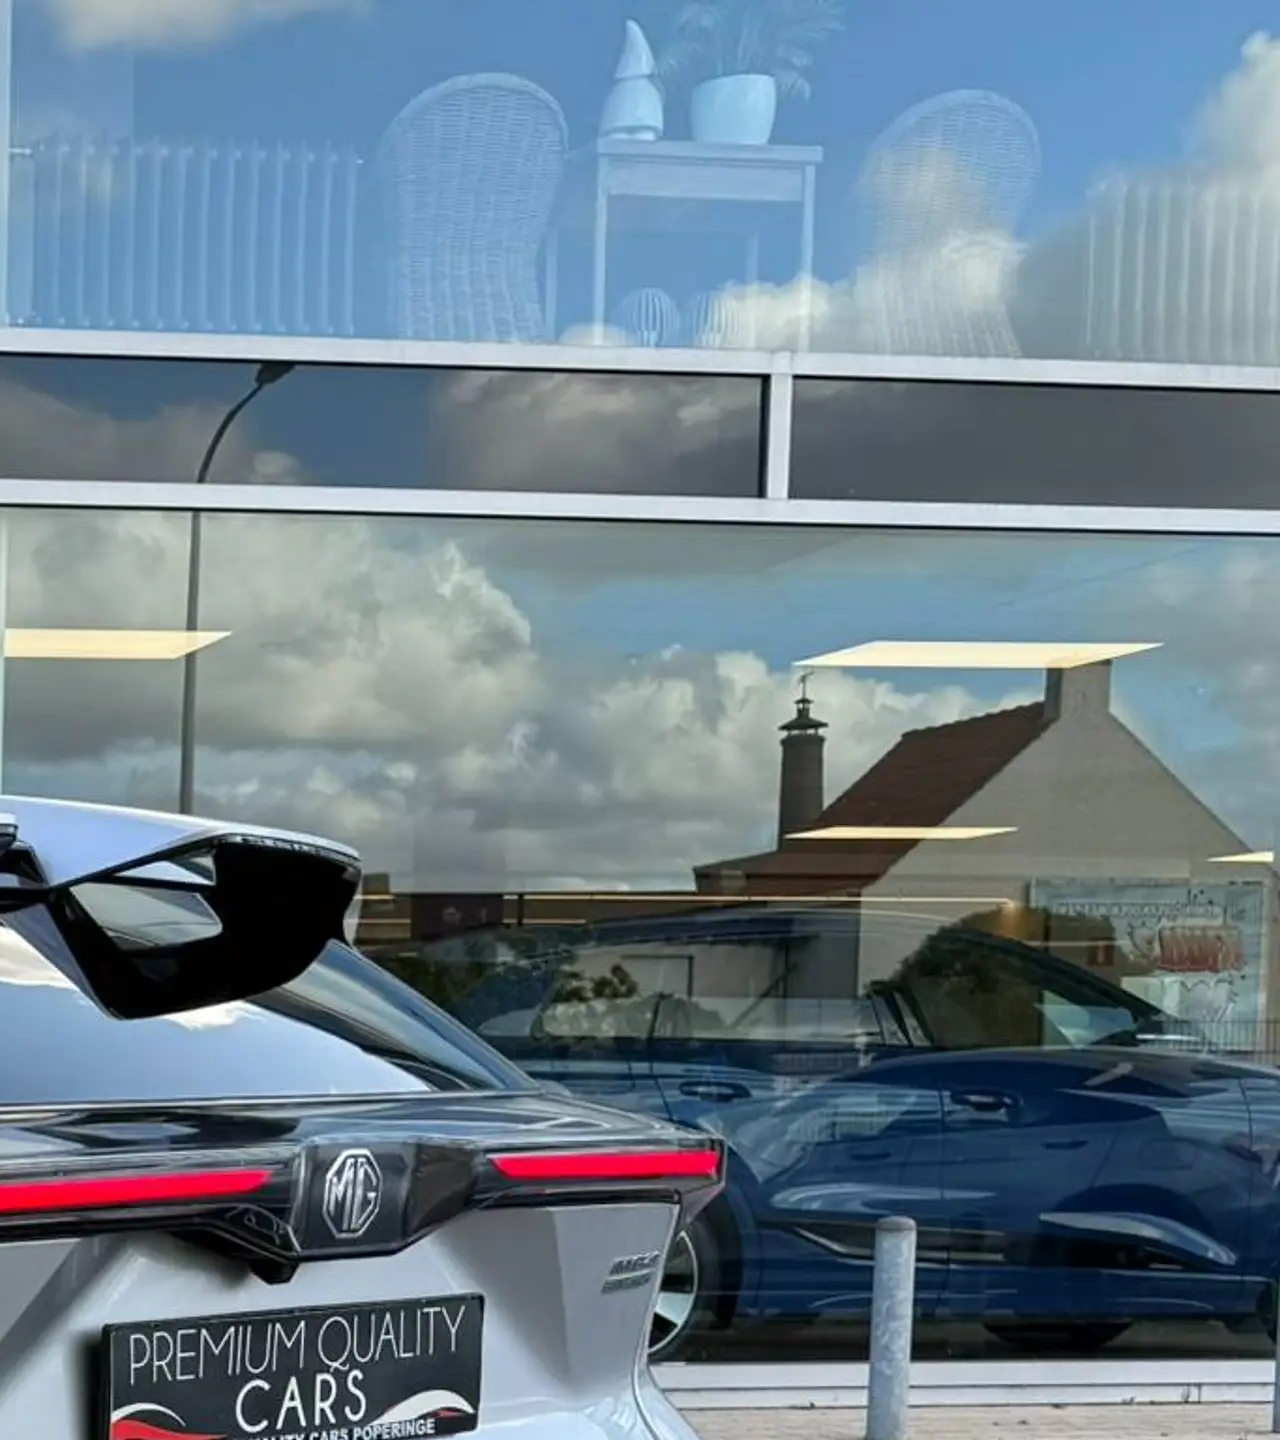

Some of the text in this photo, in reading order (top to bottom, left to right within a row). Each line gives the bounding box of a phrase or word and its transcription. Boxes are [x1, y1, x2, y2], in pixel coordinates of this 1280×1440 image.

[328, 1156, 379, 1232] MG
[129, 1304, 466, 1386] PREMIUM QUALITY
[234, 1369, 367, 1434] CARS
